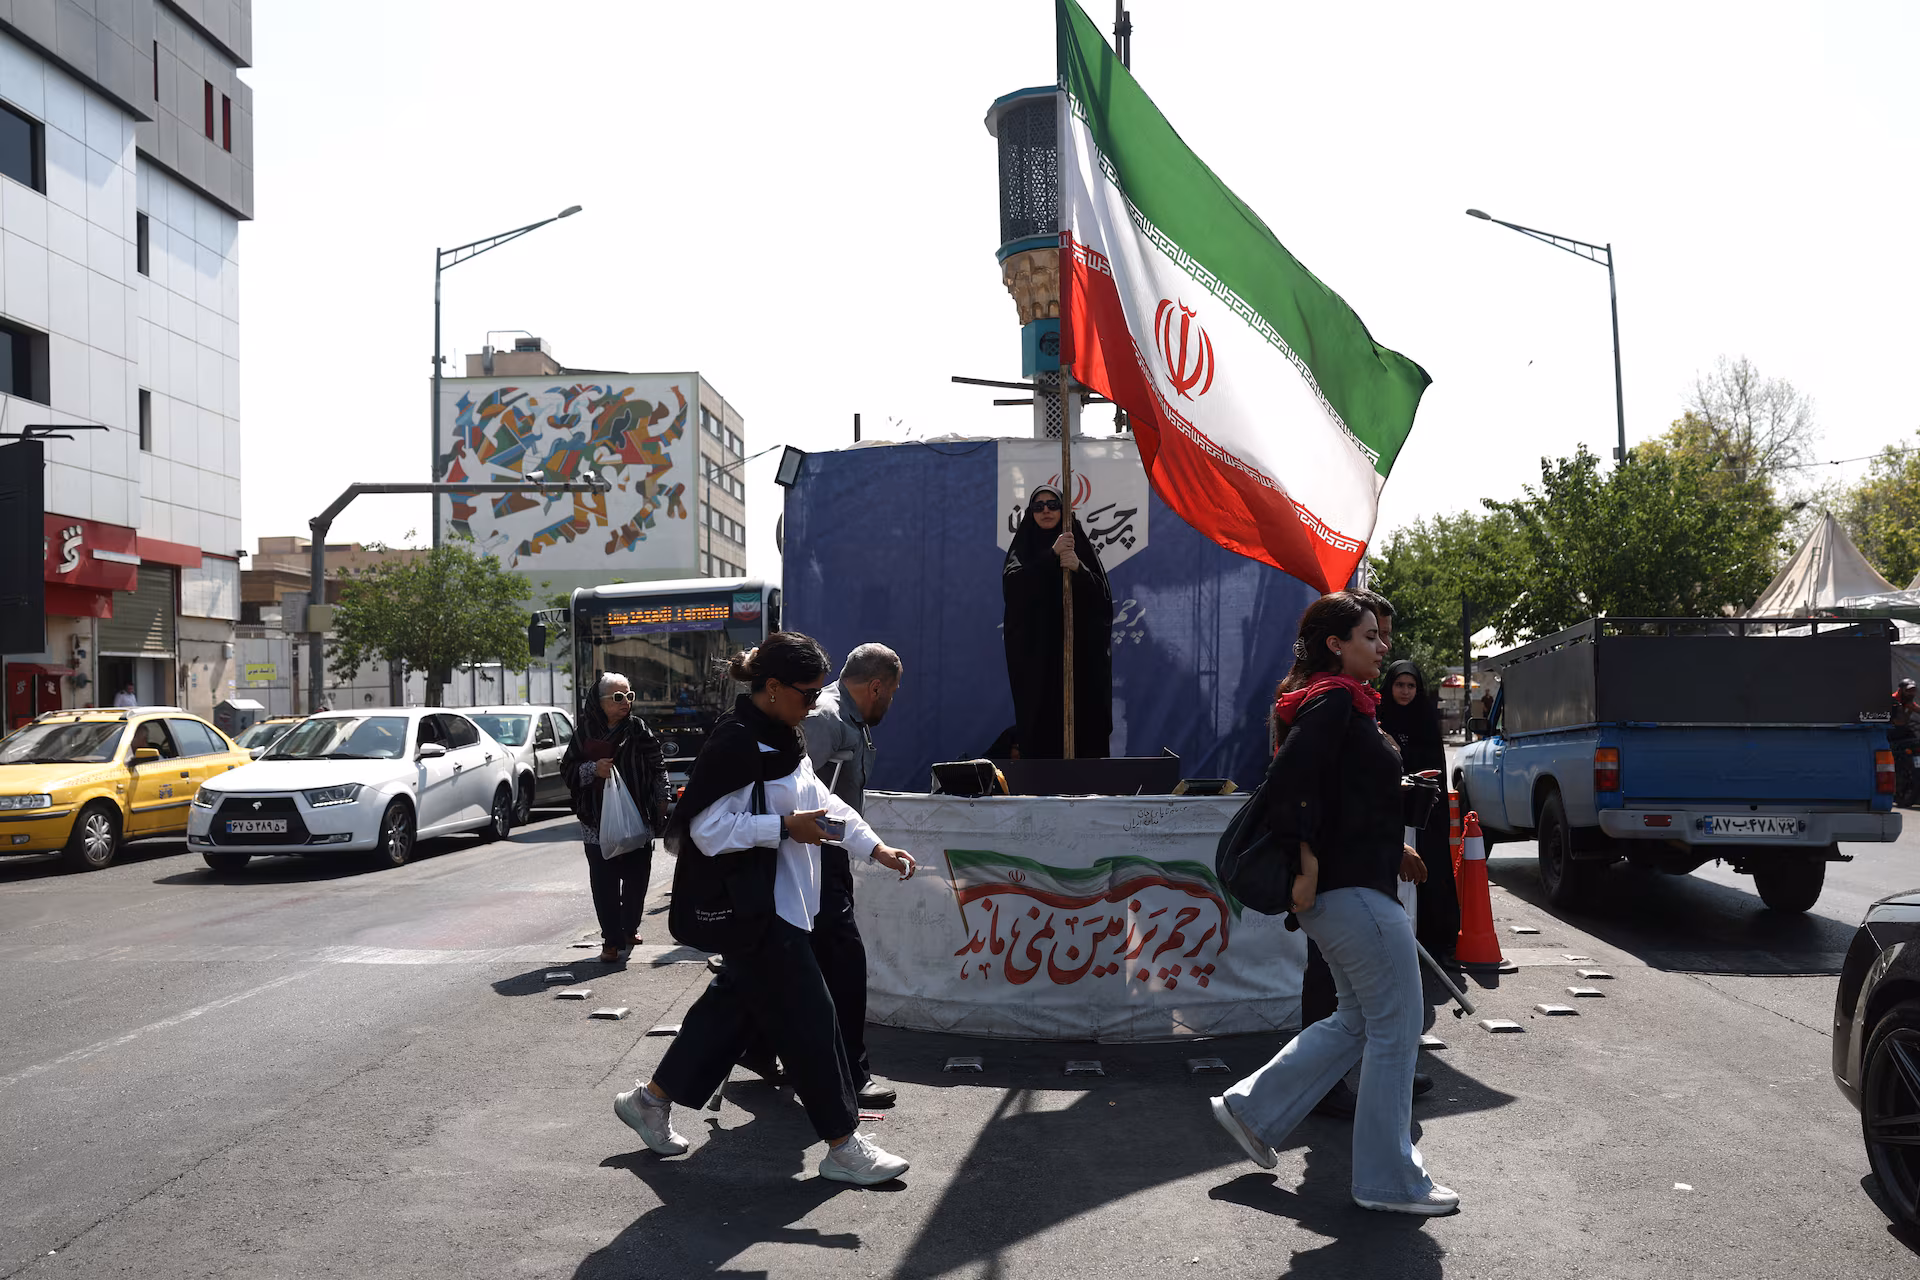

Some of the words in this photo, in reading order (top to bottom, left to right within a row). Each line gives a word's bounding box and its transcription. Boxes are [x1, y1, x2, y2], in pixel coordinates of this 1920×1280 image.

[1123, 818, 1142, 832] ایران
[1714, 818, 1731, 833] ۸۷
[1732, 821, 1748, 832] ب
[1047, 898, 1142, 986] زمین
[1124, 906, 1169, 983] بر
[1151, 905, 1217, 990] پرچم
